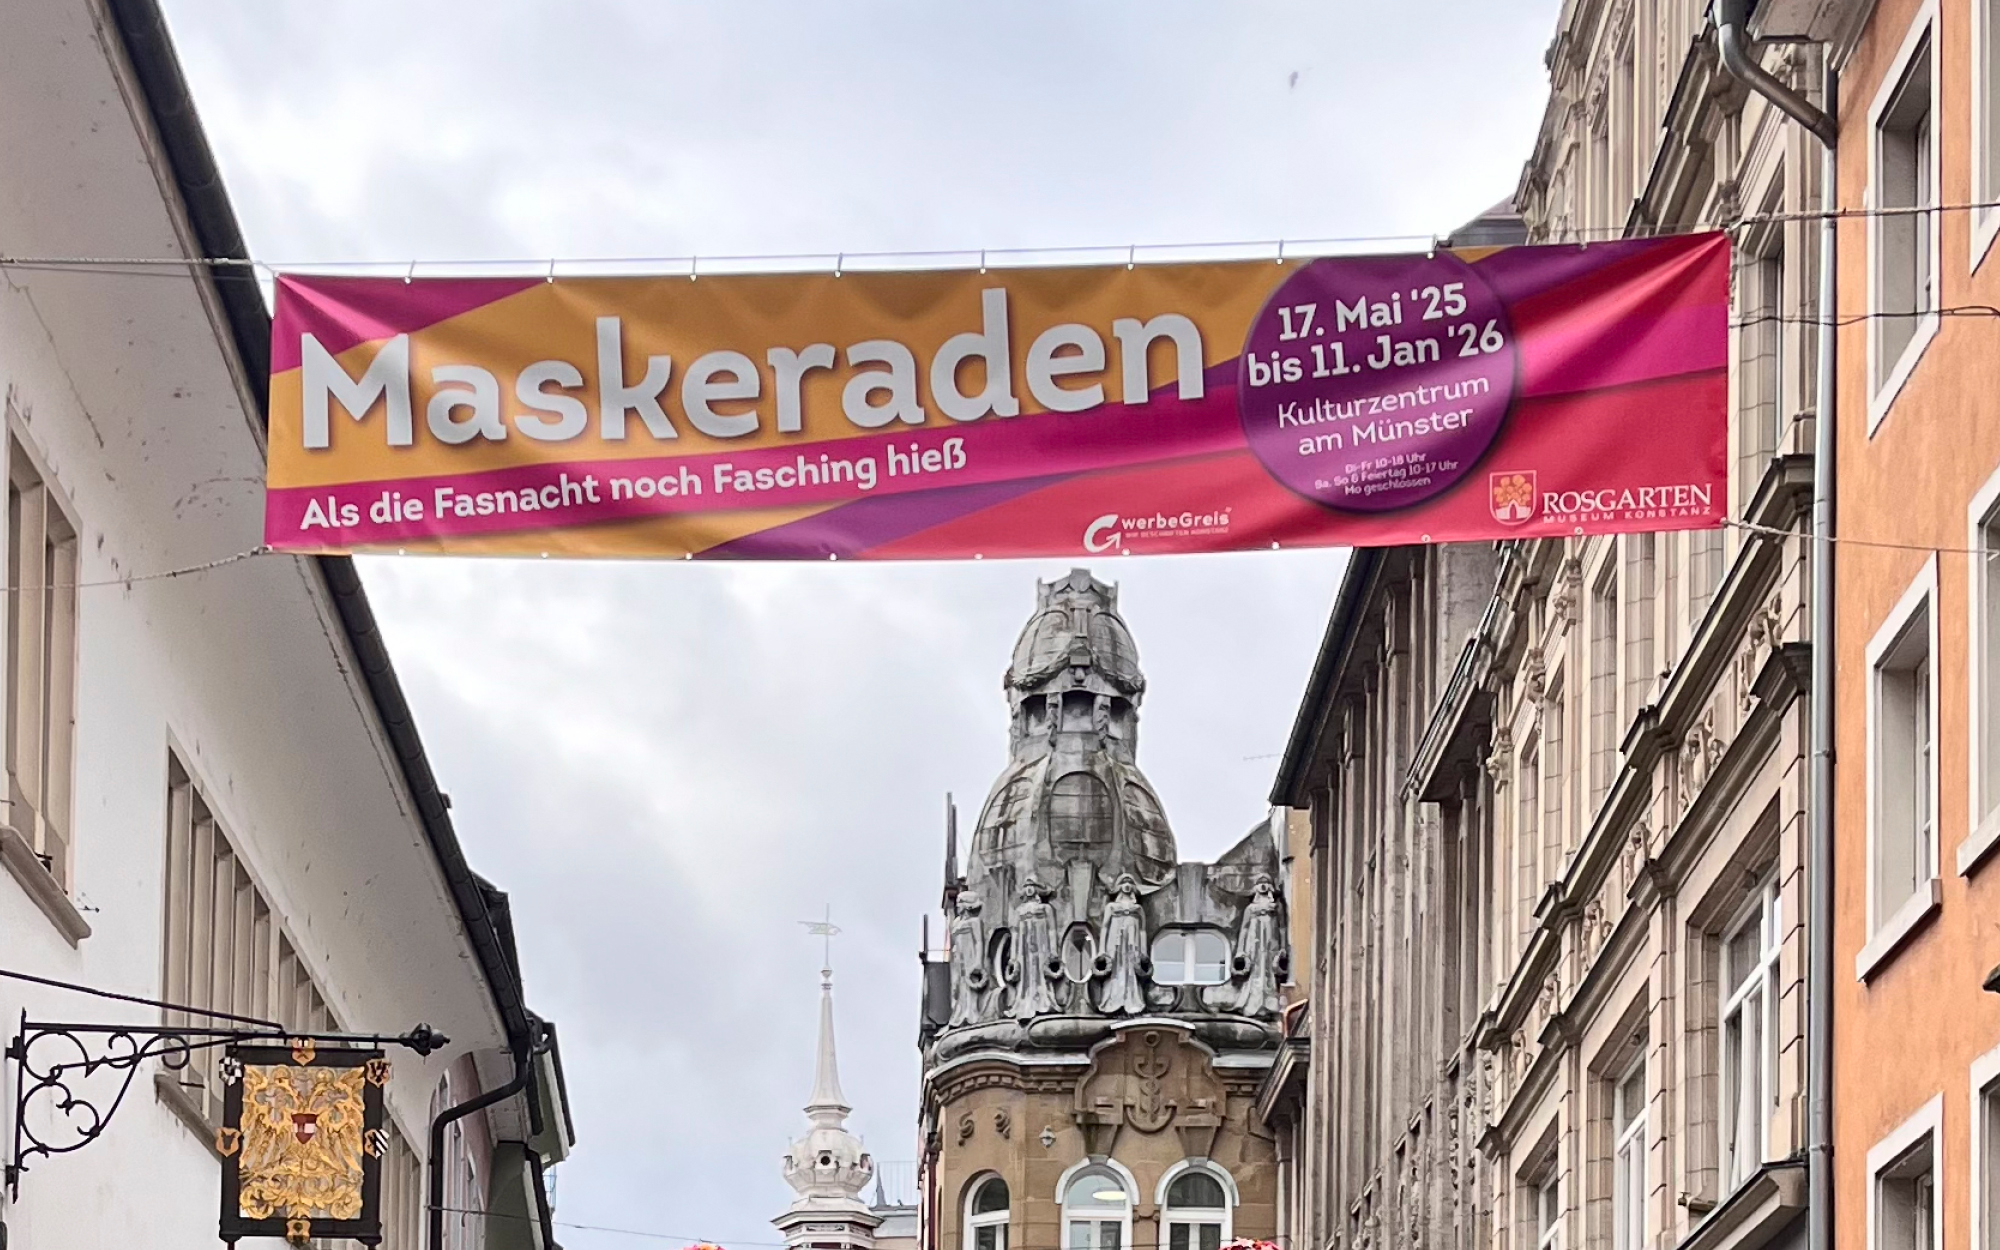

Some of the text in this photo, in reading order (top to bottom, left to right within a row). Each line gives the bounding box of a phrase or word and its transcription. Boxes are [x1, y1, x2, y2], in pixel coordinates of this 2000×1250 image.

[1278, 282, 1467, 341] 17. Mai '25
[301, 287, 1205, 449] Maskeraden
[1248, 319, 1504, 386] bis 11. Jan '26
[1278, 377, 1490, 429] Kulturzentrum
[1298, 408, 1473, 455] am Münster
[1406, 452, 1427, 464] Uhr
[1438, 459, 1459, 472] Uhr
[300, 438, 966, 530] Als die Fasnacht noch Fasching hieß
[1363, 476, 1432, 497] geschlossen
[1542, 483, 1713, 515] ROSGARTEN
[1121, 511, 1230, 530] werbeGreis
[1543, 506, 1711, 524] MUSEUM KONSTANZ
